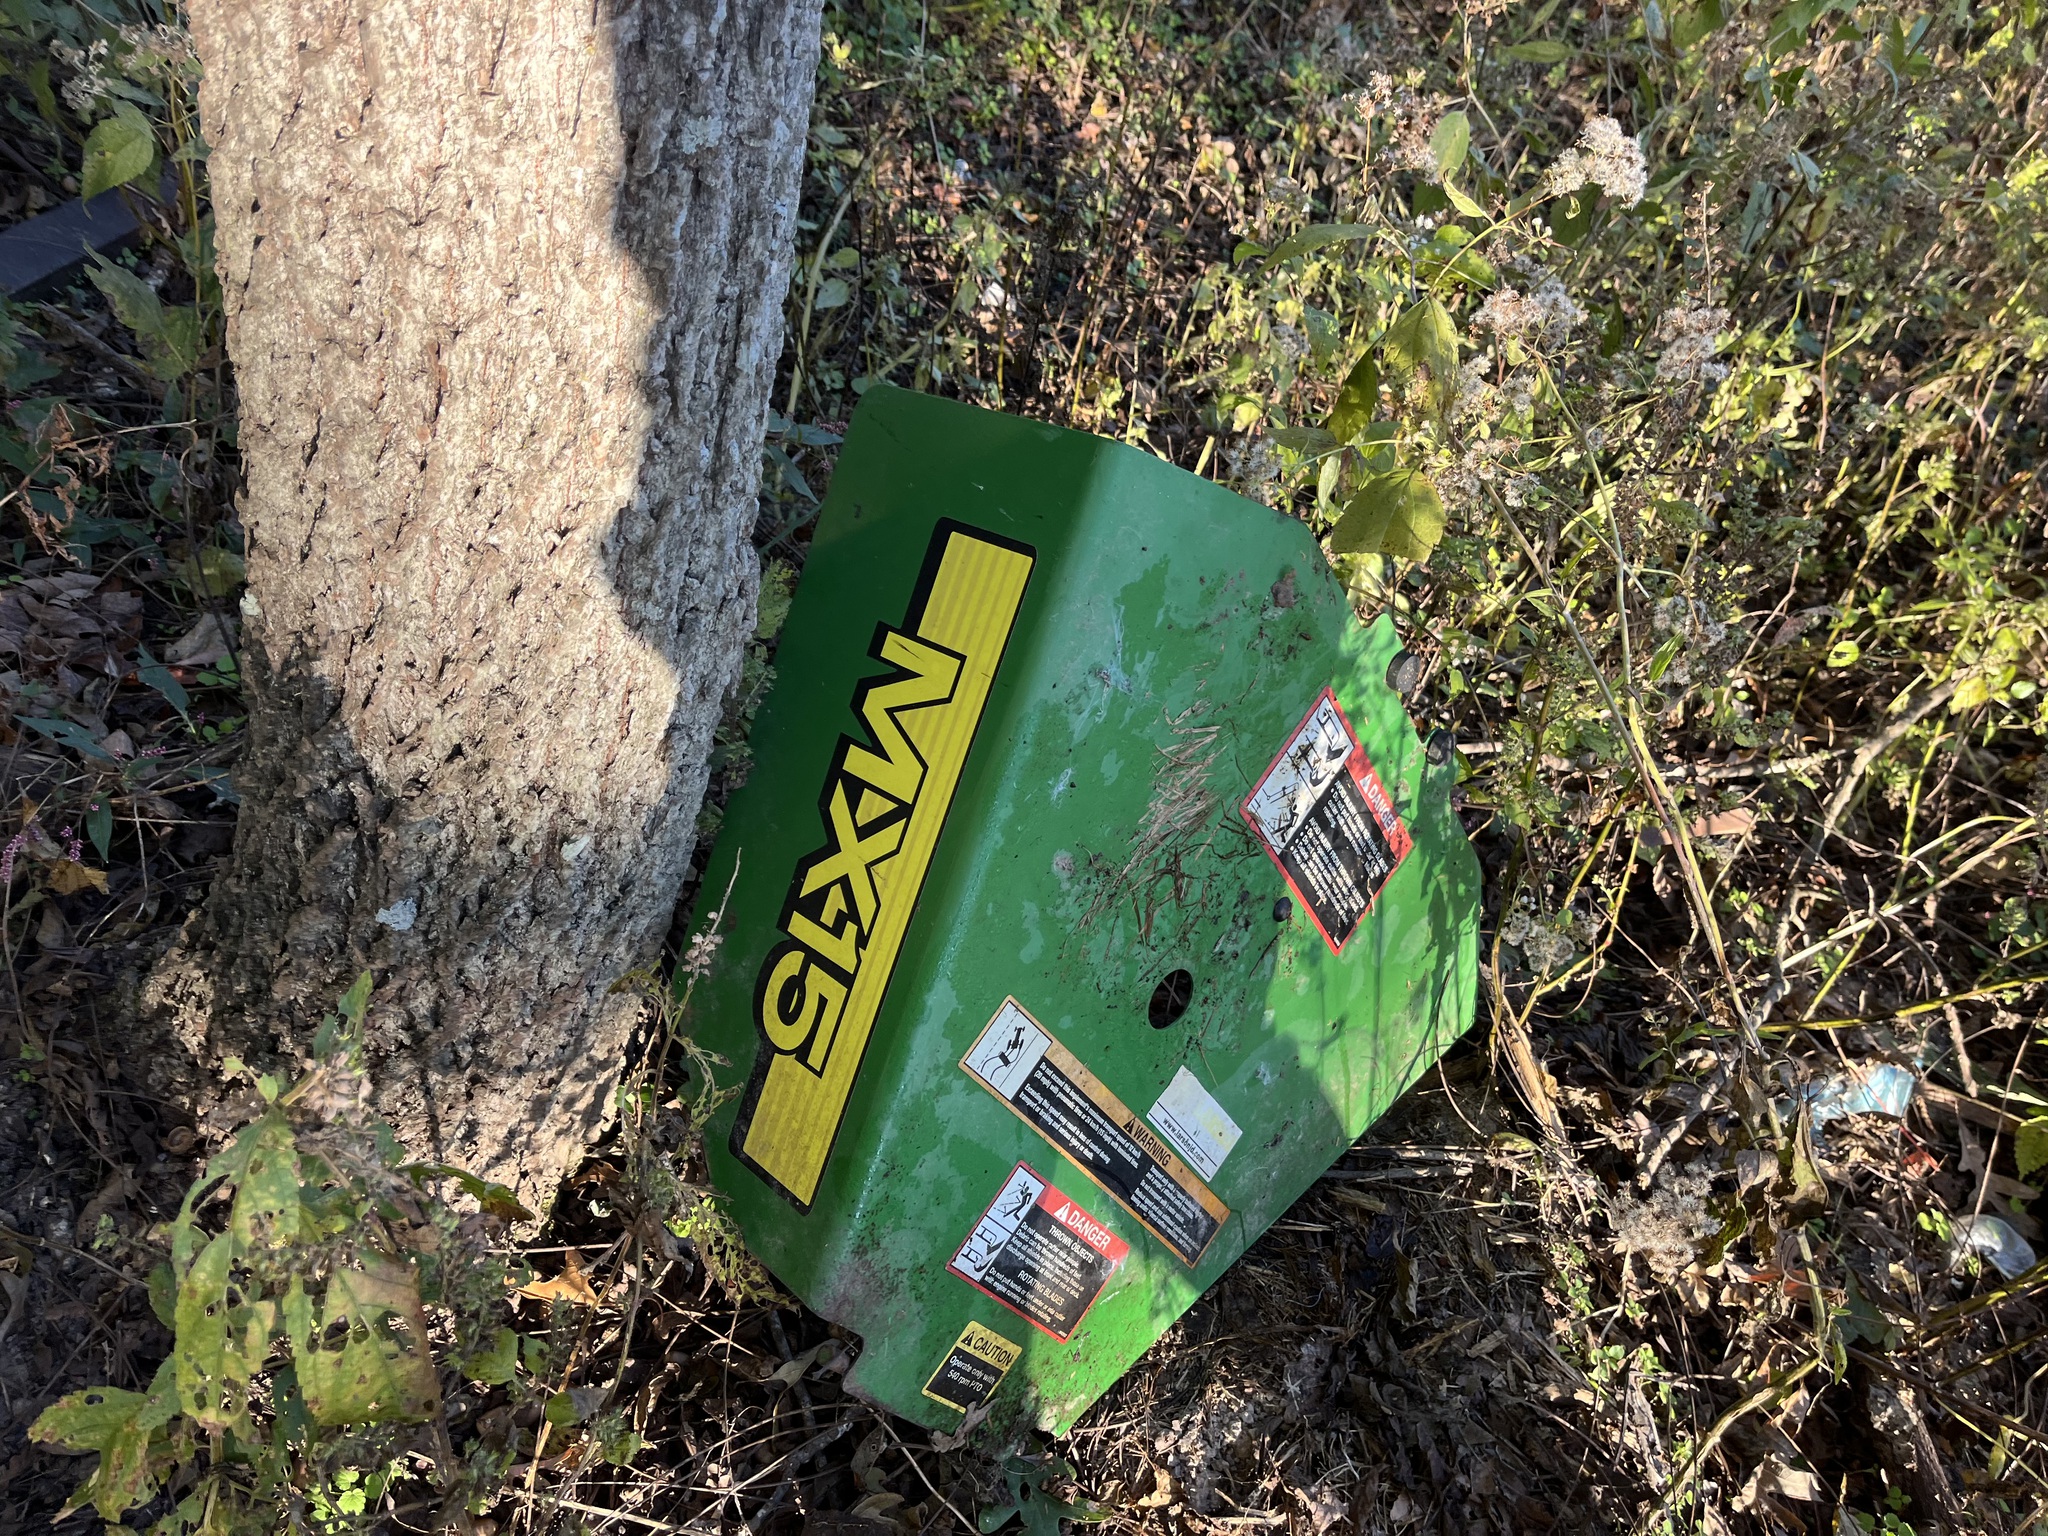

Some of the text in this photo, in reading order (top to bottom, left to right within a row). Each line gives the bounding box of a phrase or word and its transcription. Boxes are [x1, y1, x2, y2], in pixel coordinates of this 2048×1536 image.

[1334, 780, 1347, 799] AVOID
[1344, 795, 1357, 817] INJURY
[1354, 814, 1365, 832] FROM
[1362, 828, 1378, 855] ROTATING
[1375, 852, 1388, 873] BLADES
[1368, 784, 1397, 835] DANGER
[761, 628, 968, 1080] MX15
[1309, 817, 1365, 908] AVOID INJURY FROM THROWN OBJECTS
[1134, 1125, 1171, 1167] WARNING
[1163, 1118, 1204, 1164] www.larsonjd.com
[1049, 1225, 1094, 1263] THROWN OBJECTS
[1067, 1210, 1111, 1250] DANGER
[1018, 1270, 1065, 1306] ROTATING BLADES
[950, 1355, 997, 1384] Operate only with
[973, 1337, 1014, 1366] CAUTION
[947, 1369, 983, 1392] 540 rpm PTO
